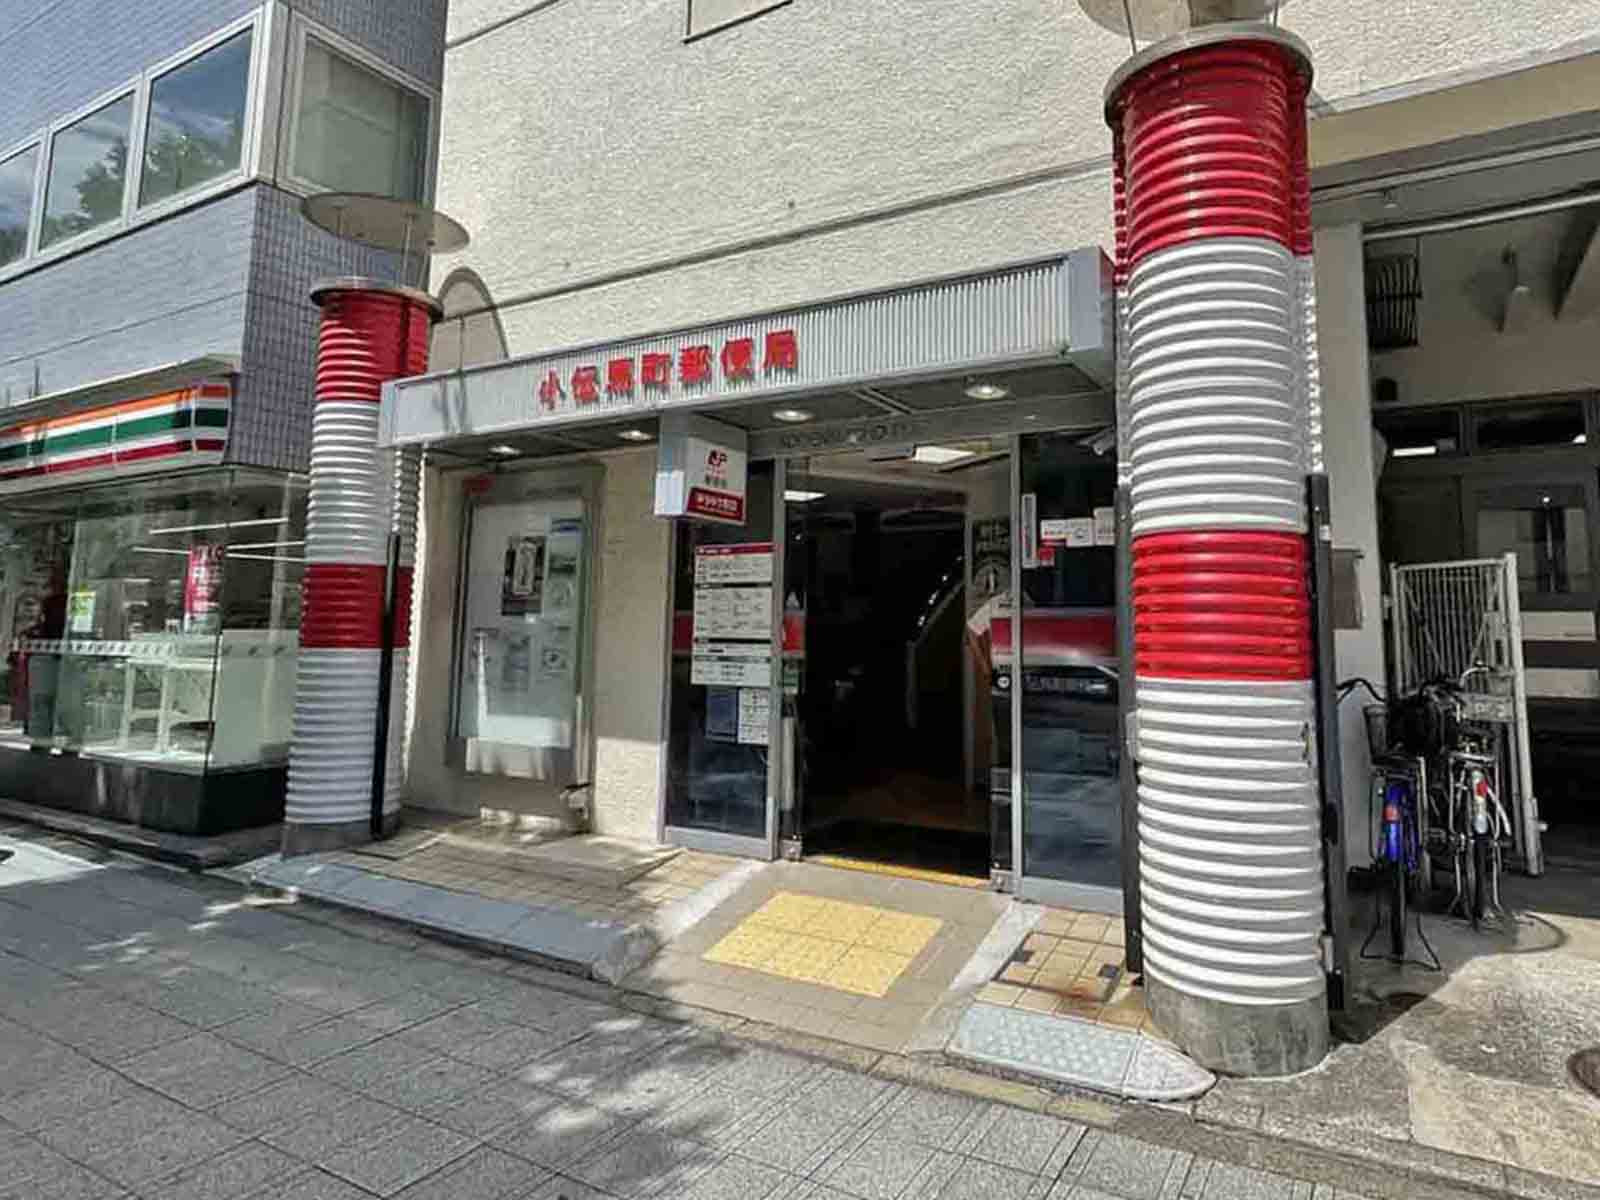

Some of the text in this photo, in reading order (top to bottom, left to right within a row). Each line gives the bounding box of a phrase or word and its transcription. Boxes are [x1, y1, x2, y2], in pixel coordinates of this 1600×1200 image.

[538, 329, 799, 411] 小伝馬町郵便局
